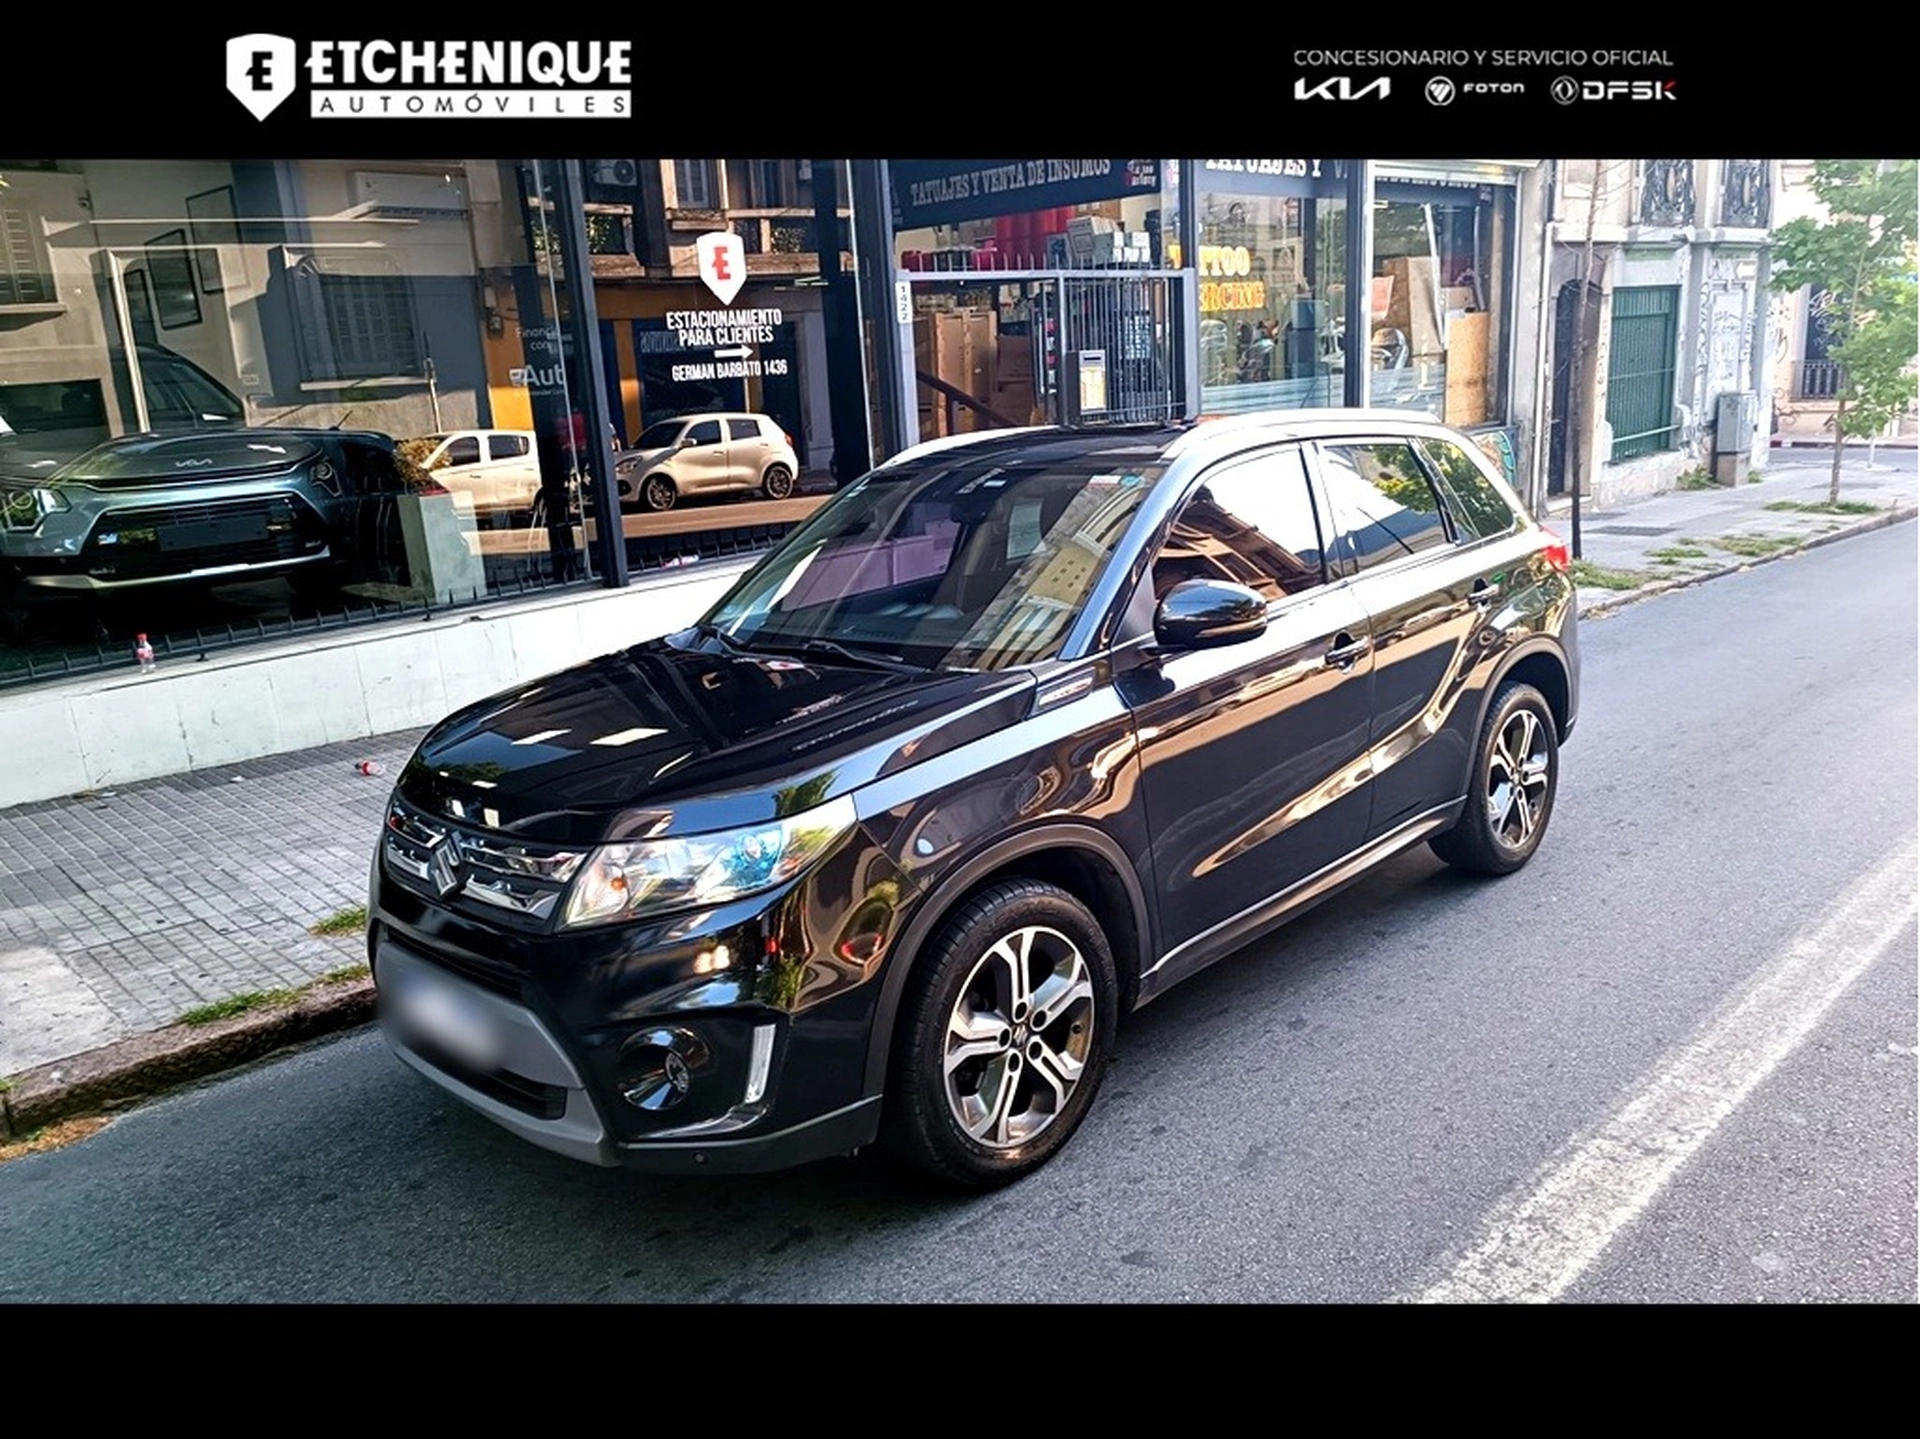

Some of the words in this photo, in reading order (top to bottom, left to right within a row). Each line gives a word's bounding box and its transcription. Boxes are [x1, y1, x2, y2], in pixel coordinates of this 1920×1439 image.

[910, 174, 970, 206] TATUAJES
[971, 172, 980, 196] Y
[981, 164, 1025, 194] VENTA
[1027, 161, 1045, 187] DE
[1047, 159, 1111, 182] INSUMOS
[666, 308, 782, 330] ESTACIONAMIENTO
[678, 328, 714, 346] PARA
[715, 326, 774, 345] CLIENTES
[671, 363, 715, 382] GERMAN
[716, 361, 761, 379] BARBATO
[763, 359, 788, 376] 1436
